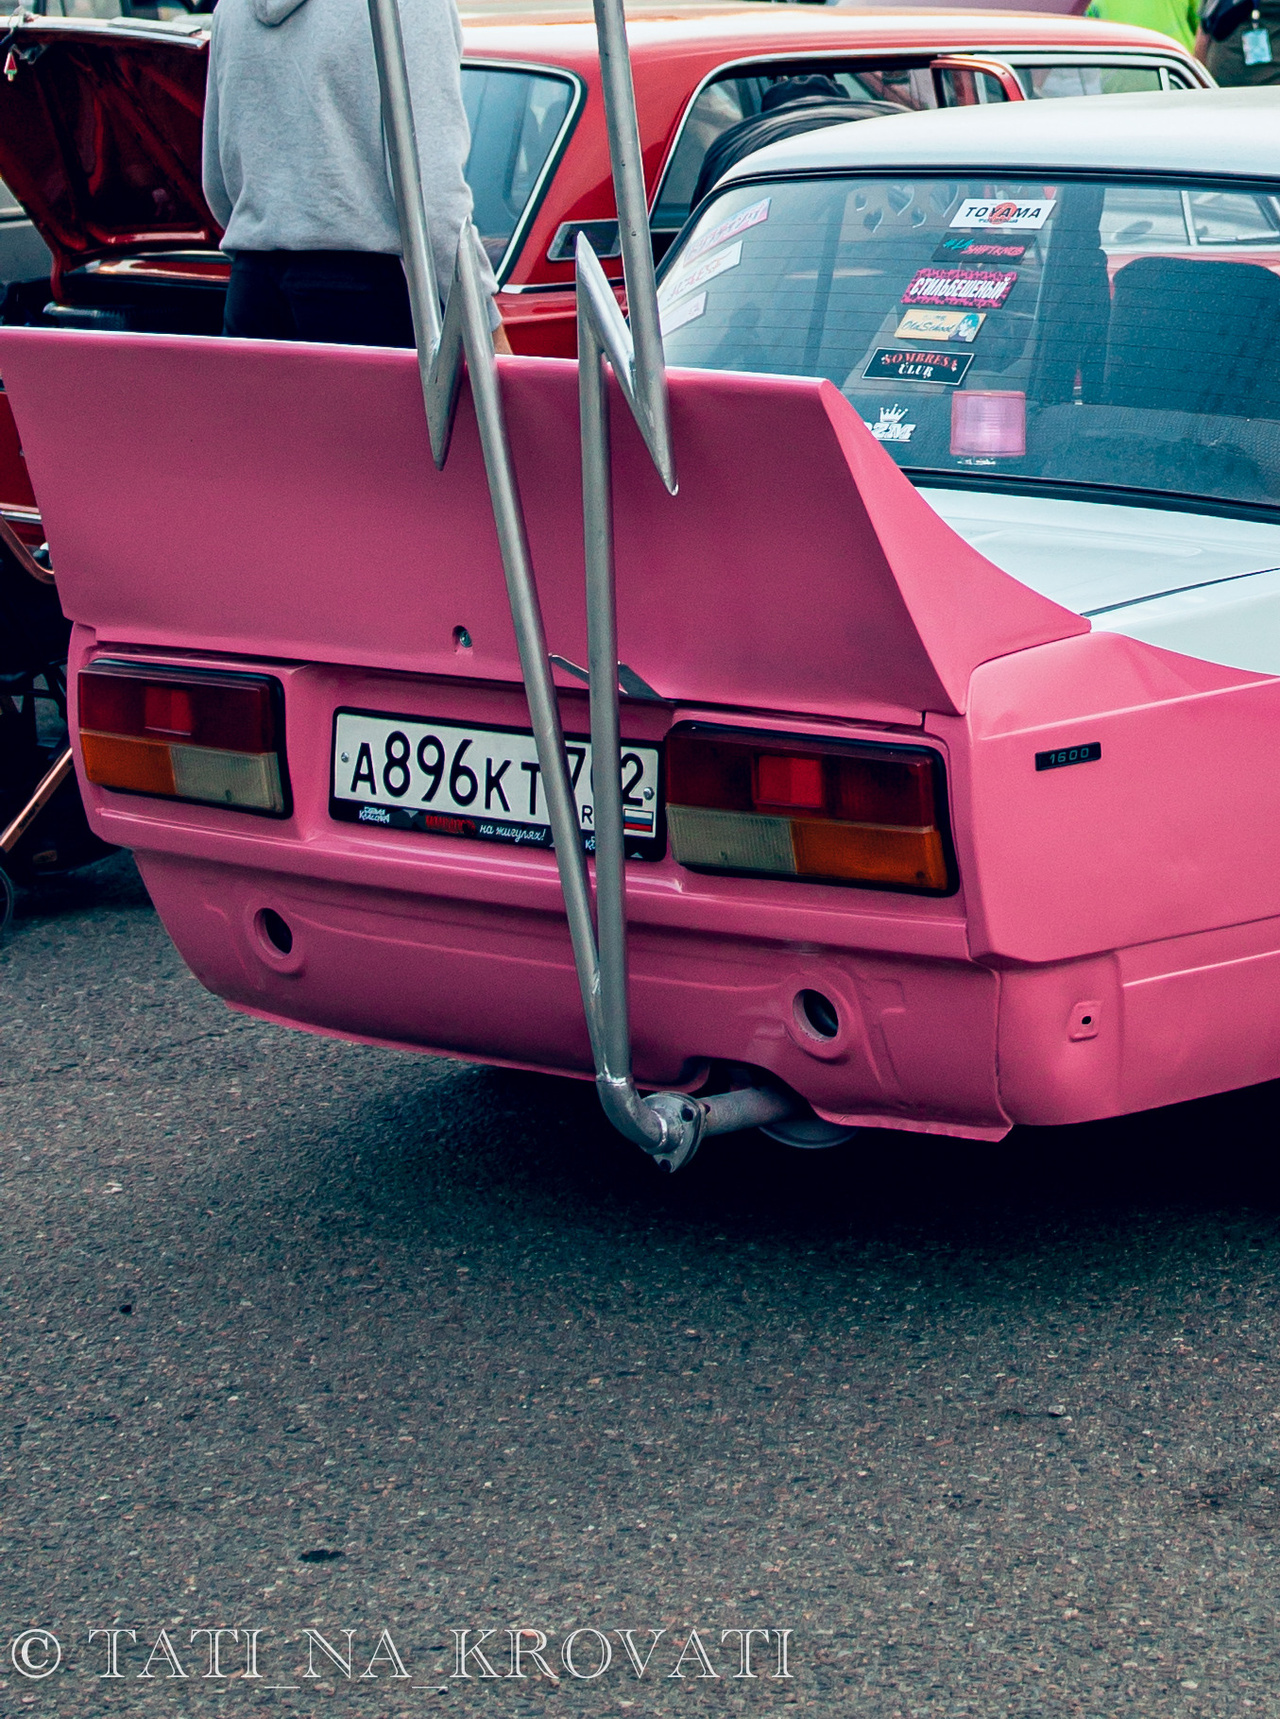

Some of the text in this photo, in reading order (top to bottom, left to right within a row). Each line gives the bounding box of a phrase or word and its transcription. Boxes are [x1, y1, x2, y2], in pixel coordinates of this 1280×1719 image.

[965, 206, 1042, 219] TOYAMA
[909, 276, 1010, 300] СТИЛЬБЕШЕНЫЙ
[1049, 747, 1090, 765] 1600
[565, 745, 645, 808] 72
[479, 824, 494, 835] на
